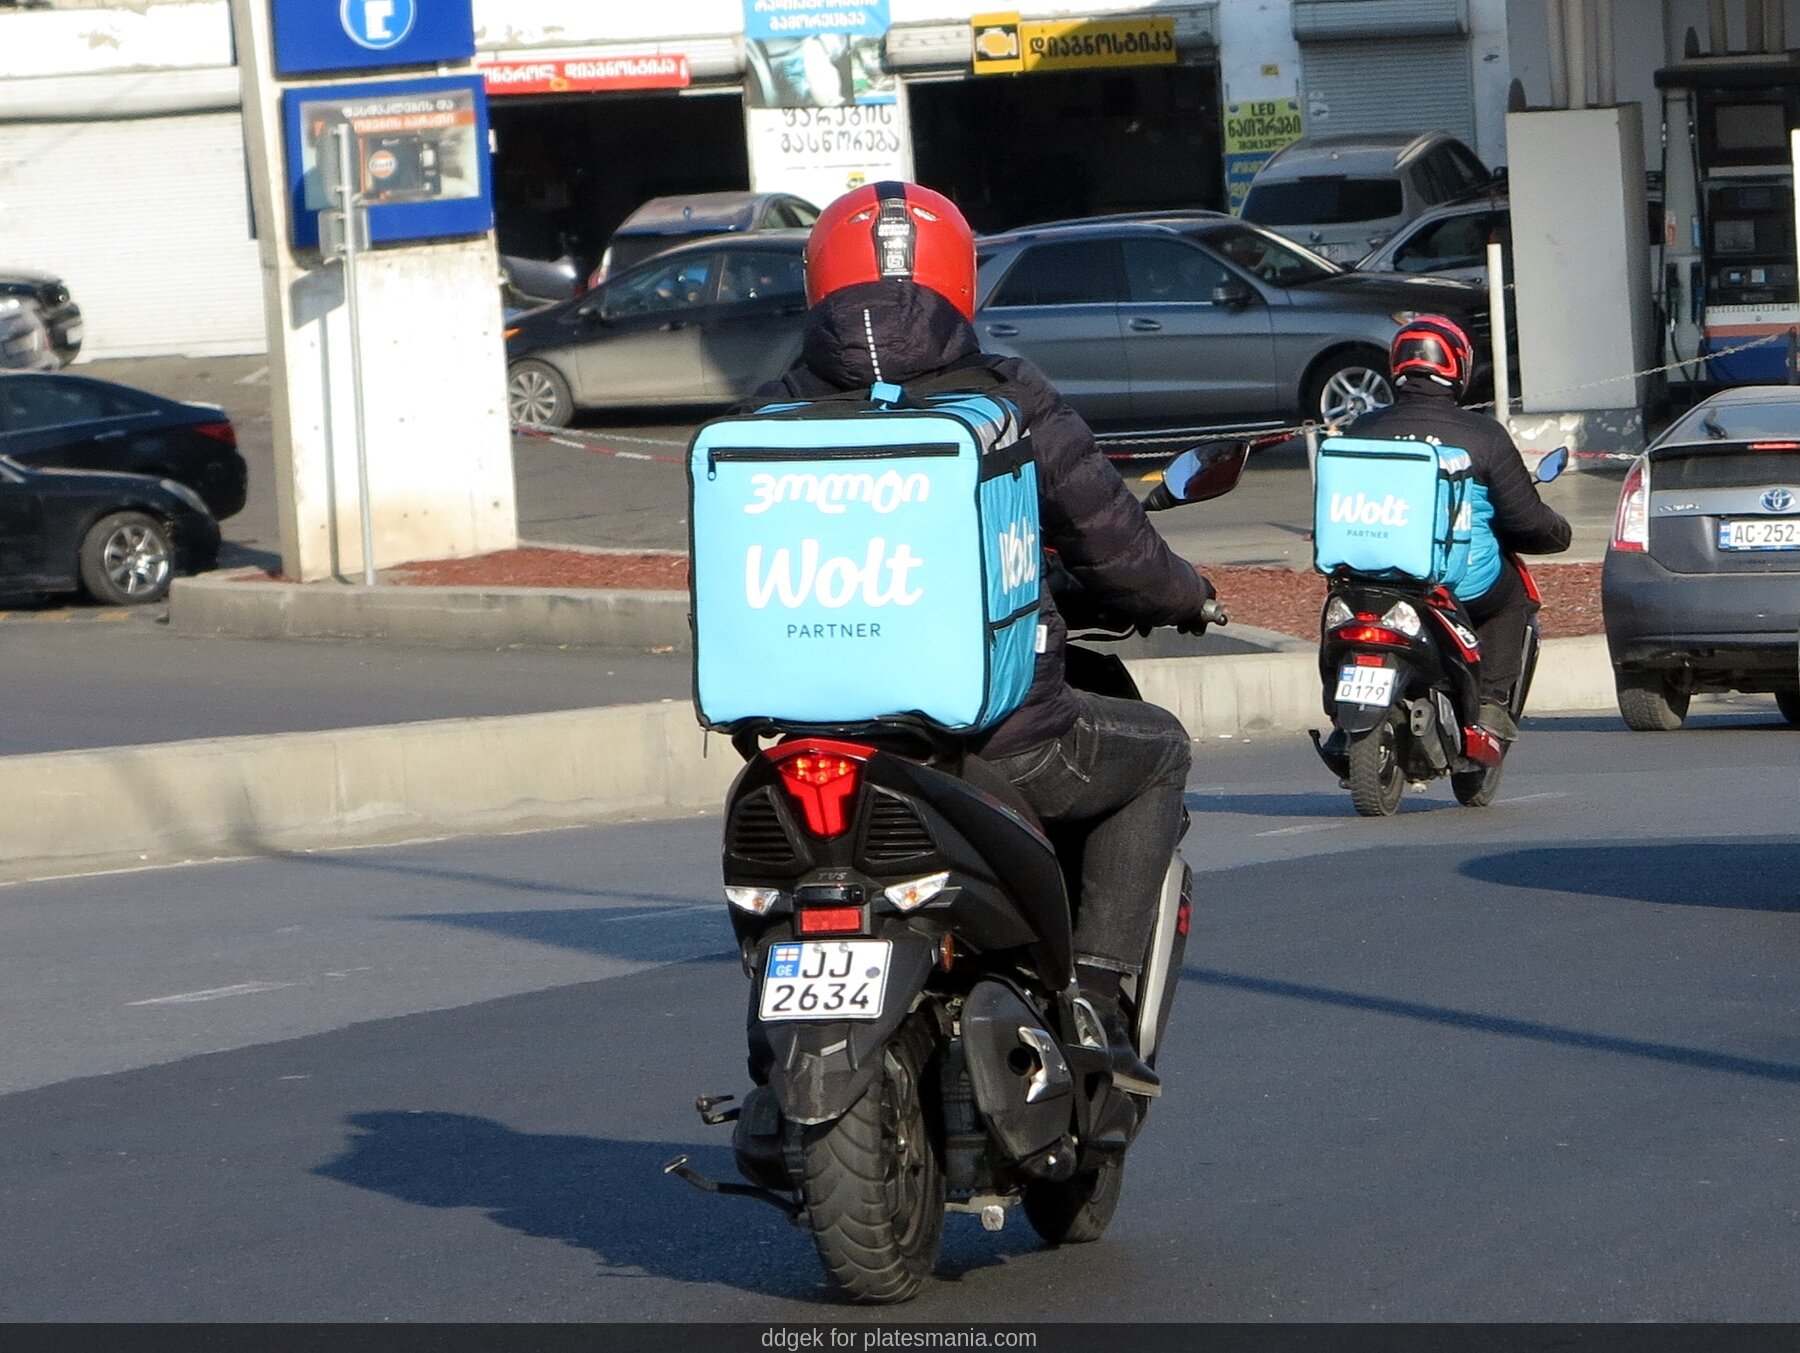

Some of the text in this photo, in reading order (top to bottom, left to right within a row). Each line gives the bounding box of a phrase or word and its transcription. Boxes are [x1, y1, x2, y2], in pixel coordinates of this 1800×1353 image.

[1029, 30, 1174, 59] დიაგნოსტიკა
[781, 107, 892, 127] ფარების
[1251, 102, 1276, 116] LED
[1227, 115, 1302, 138] ნათურები
[781, 130, 900, 152] გასწორება
[1329, 492, 1410, 527] Wolt
[1347, 529, 1389, 539] PARTNER
[999, 516, 1036, 596] Wolt
[744, 536, 925, 609] Wolt
[787, 623, 882, 638] PARTNER
[1341, 685, 1386, 701] 0179
[818, 871, 848, 881] TVS
[775, 948, 853, 979] GE JJ
[772, 983, 870, 1012] 2634
